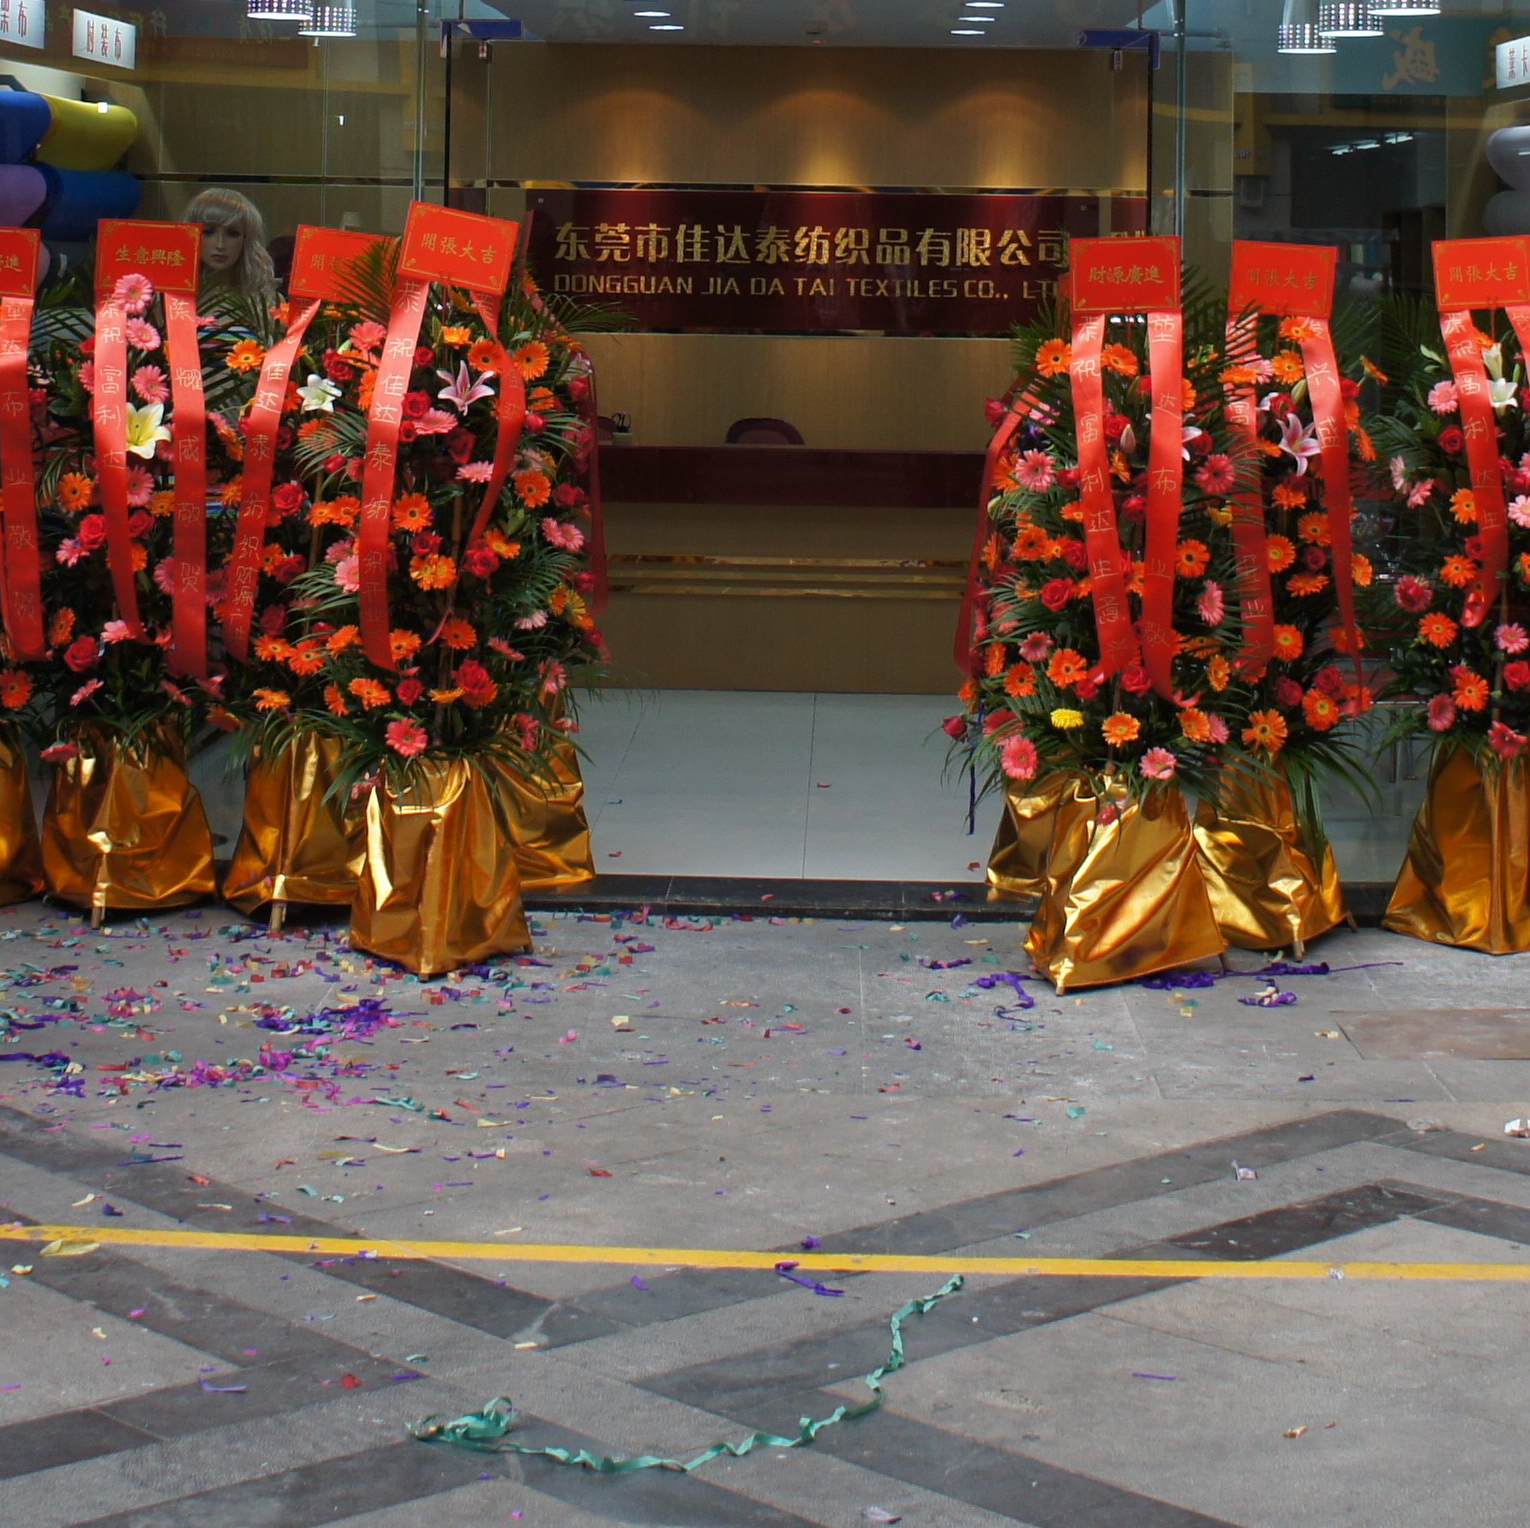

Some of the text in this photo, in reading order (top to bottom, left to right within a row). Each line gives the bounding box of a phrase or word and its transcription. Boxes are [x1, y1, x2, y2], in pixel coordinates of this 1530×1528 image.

[701, 276, 741, 296] JIA
[795, 278, 835, 297] TAI
[846, 278, 959, 300] TEXTILES
